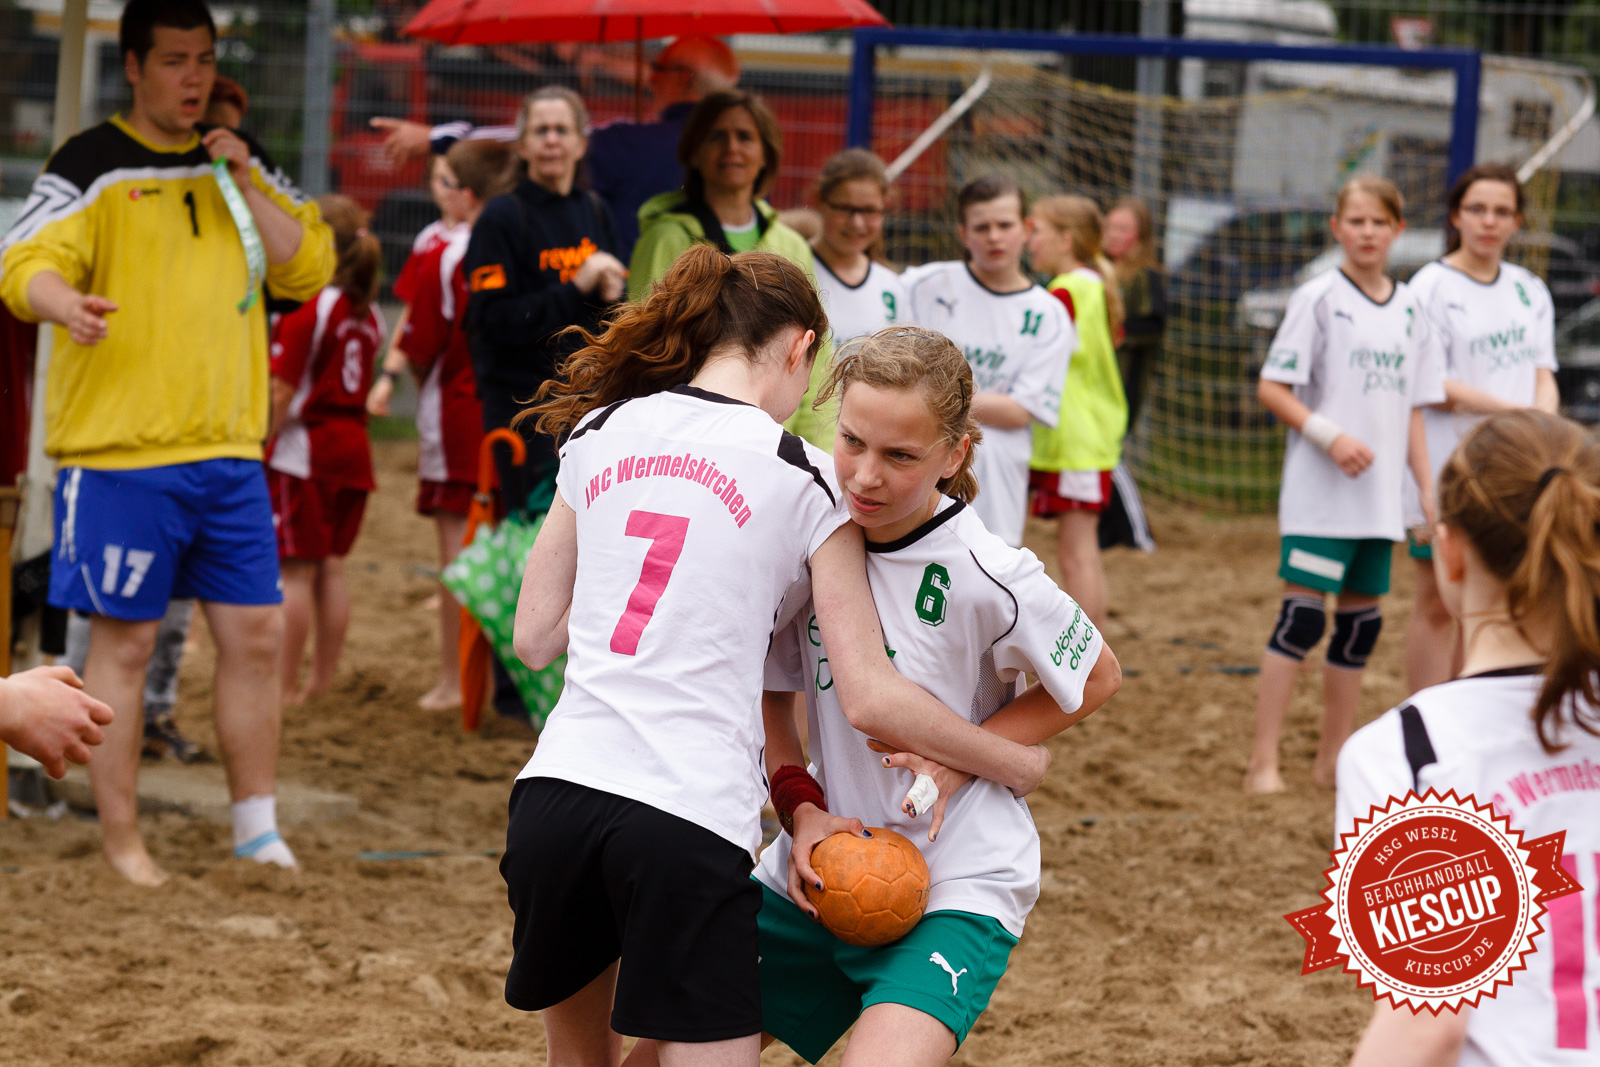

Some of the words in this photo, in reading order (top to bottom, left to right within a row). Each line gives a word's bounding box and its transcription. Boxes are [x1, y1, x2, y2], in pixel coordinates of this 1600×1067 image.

[183, 191, 200, 237] 1
[882, 291, 897, 322] 9
[585, 467, 612, 509] JHC
[617, 453, 752, 529] Wermelskirchen
[101, 544, 156, 598] 17
[609, 510, 690, 656] 7
[915, 562, 951, 627] 6
